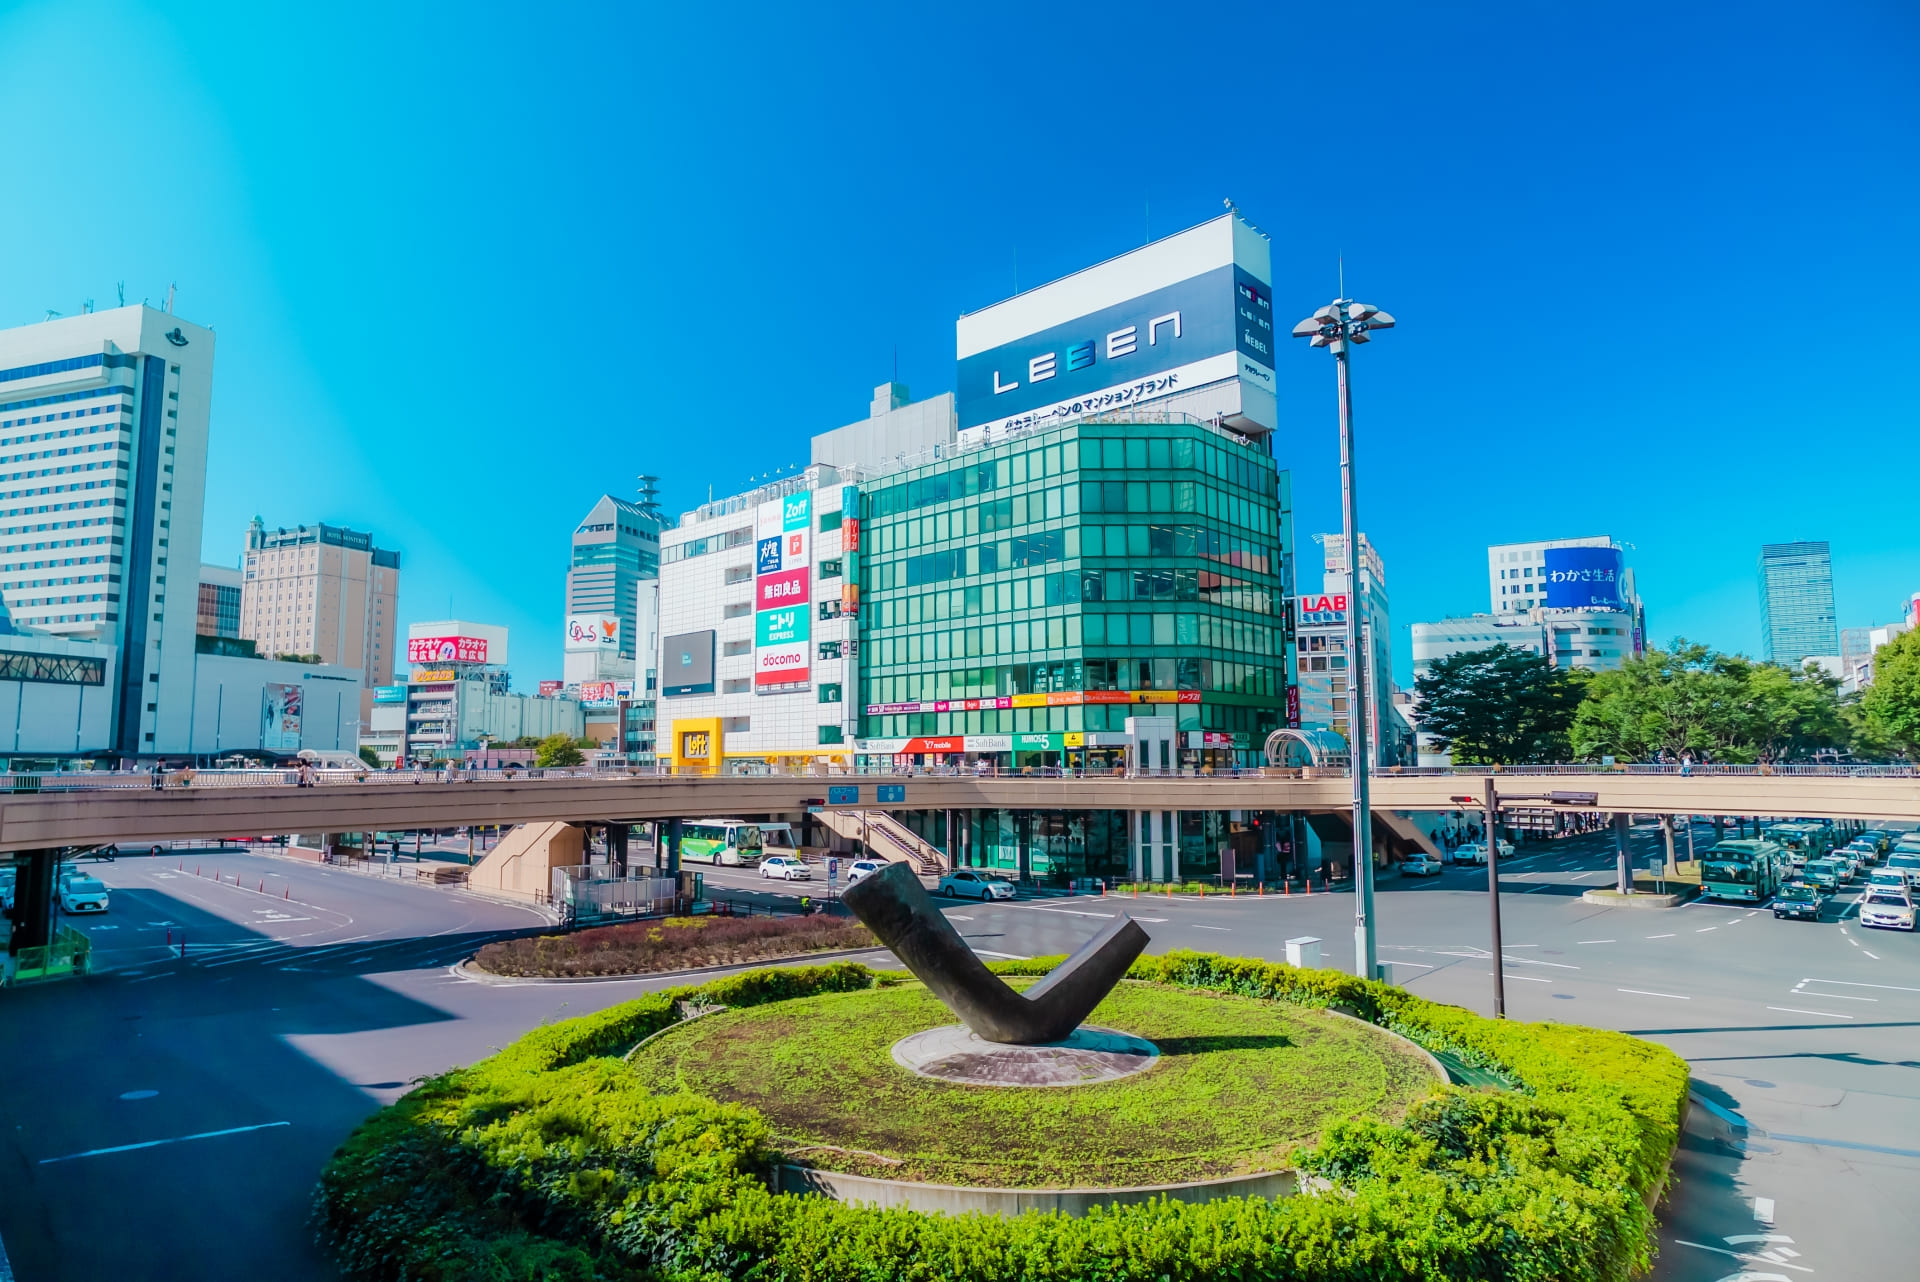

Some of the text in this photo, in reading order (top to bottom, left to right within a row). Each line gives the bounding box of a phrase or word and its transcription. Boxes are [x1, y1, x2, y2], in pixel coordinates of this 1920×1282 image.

[786, 499, 808, 519] Zoff
[1550, 568, 1615, 583] わかさ生活
[764, 580, 801, 600] 無印良品
[769, 612, 795, 631] ニトリ
[768, 631, 794, 641] EXPRESS
[409, 639, 442, 650] カラオケ
[458, 638, 487, 650] カラオケ
[762, 653, 801, 667] docomo
[975, 737, 1007, 748] SoftBank
